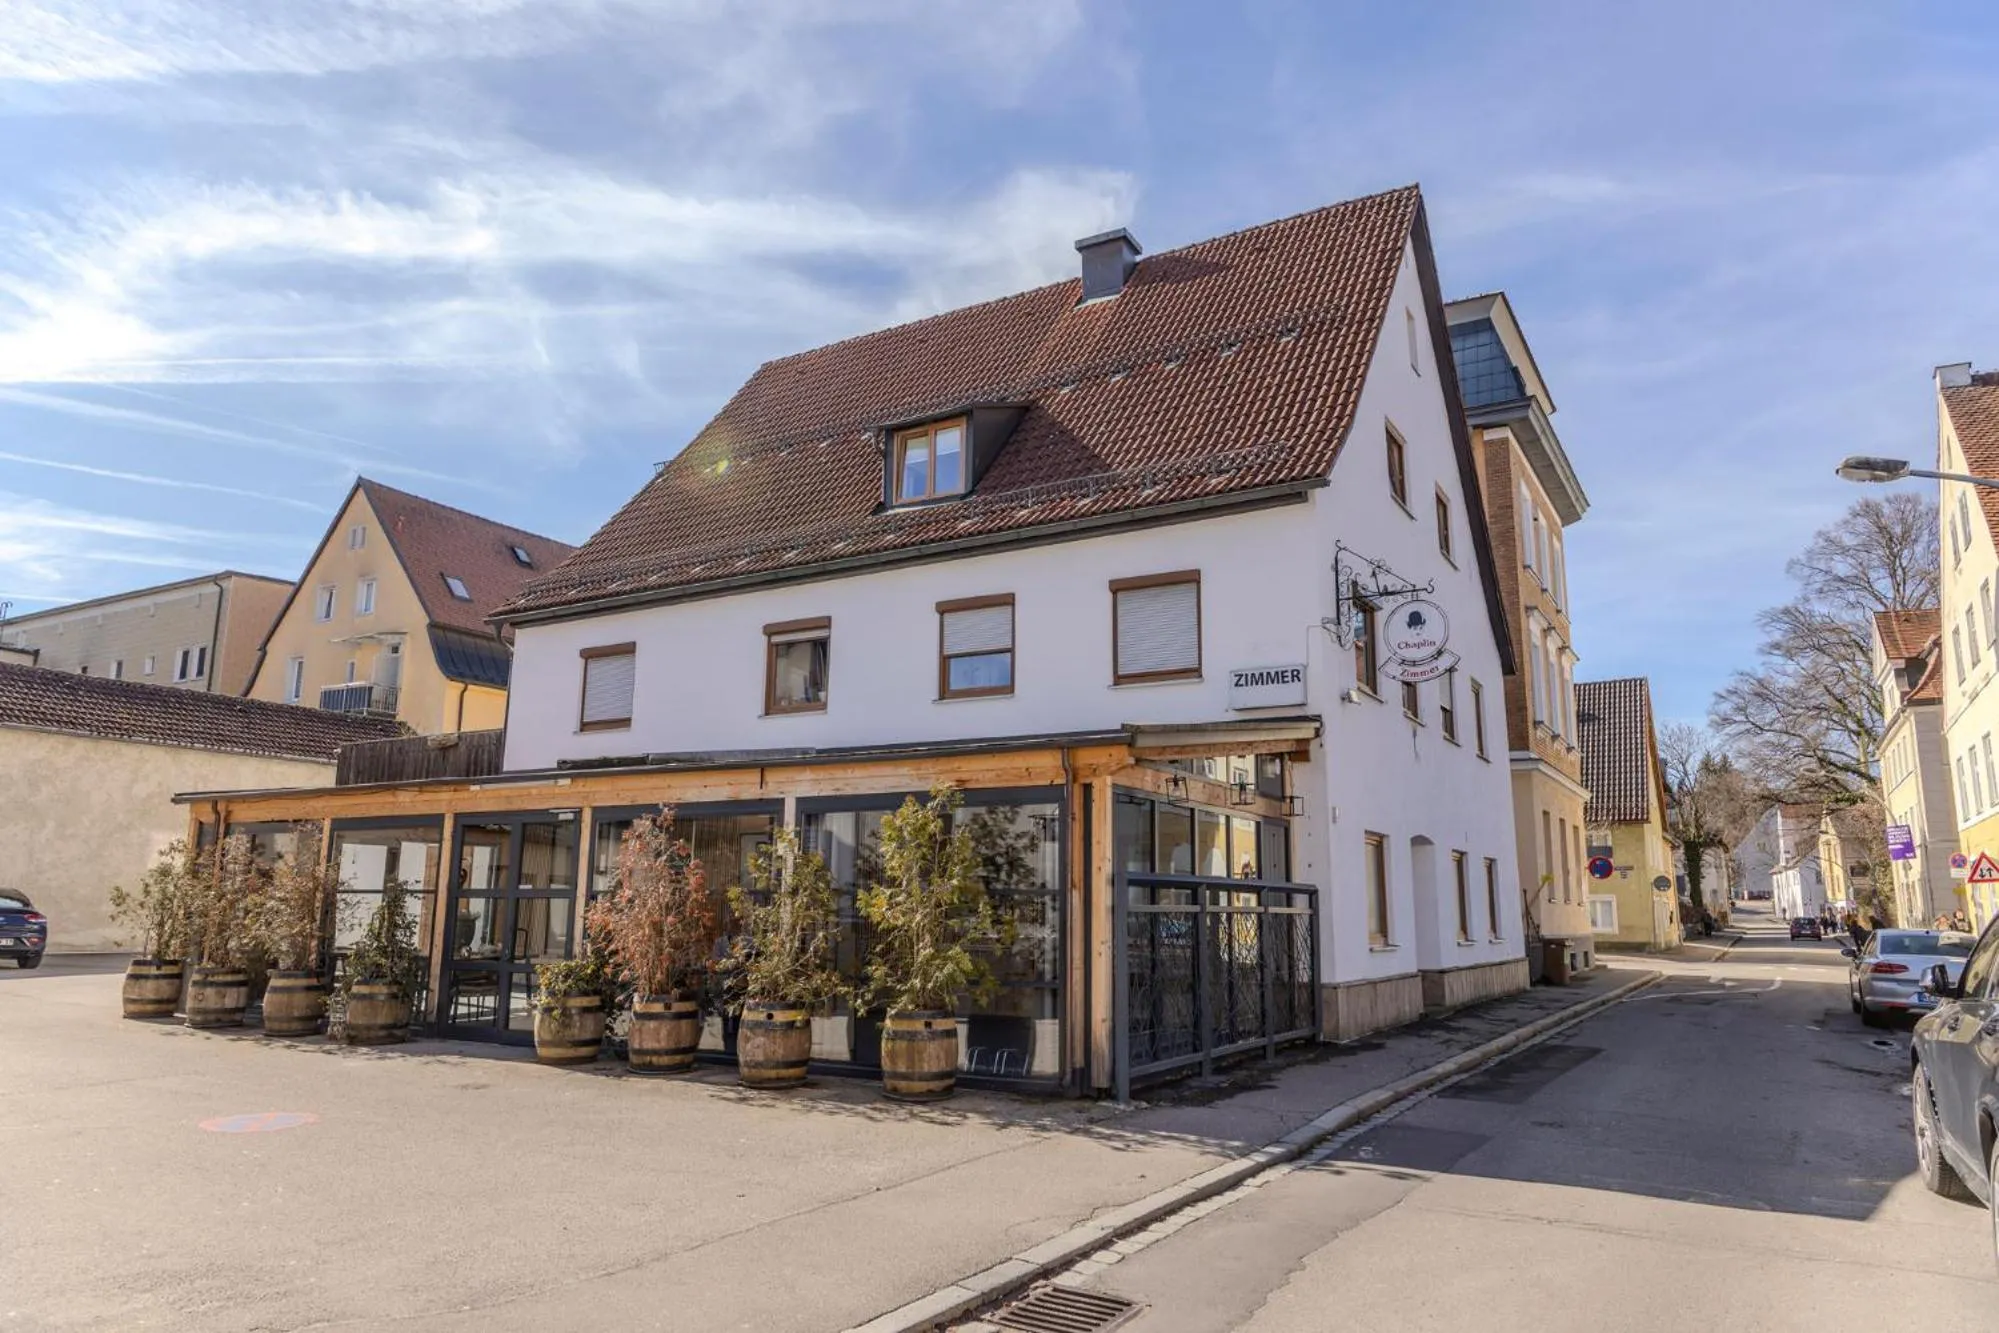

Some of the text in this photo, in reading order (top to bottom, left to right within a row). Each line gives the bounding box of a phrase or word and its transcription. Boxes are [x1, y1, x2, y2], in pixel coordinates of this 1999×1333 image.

[1397, 638, 1436, 650] Chaplin
[1234, 668, 1301, 688] ZIMMER
[1400, 665, 1439, 679] Zimmer
